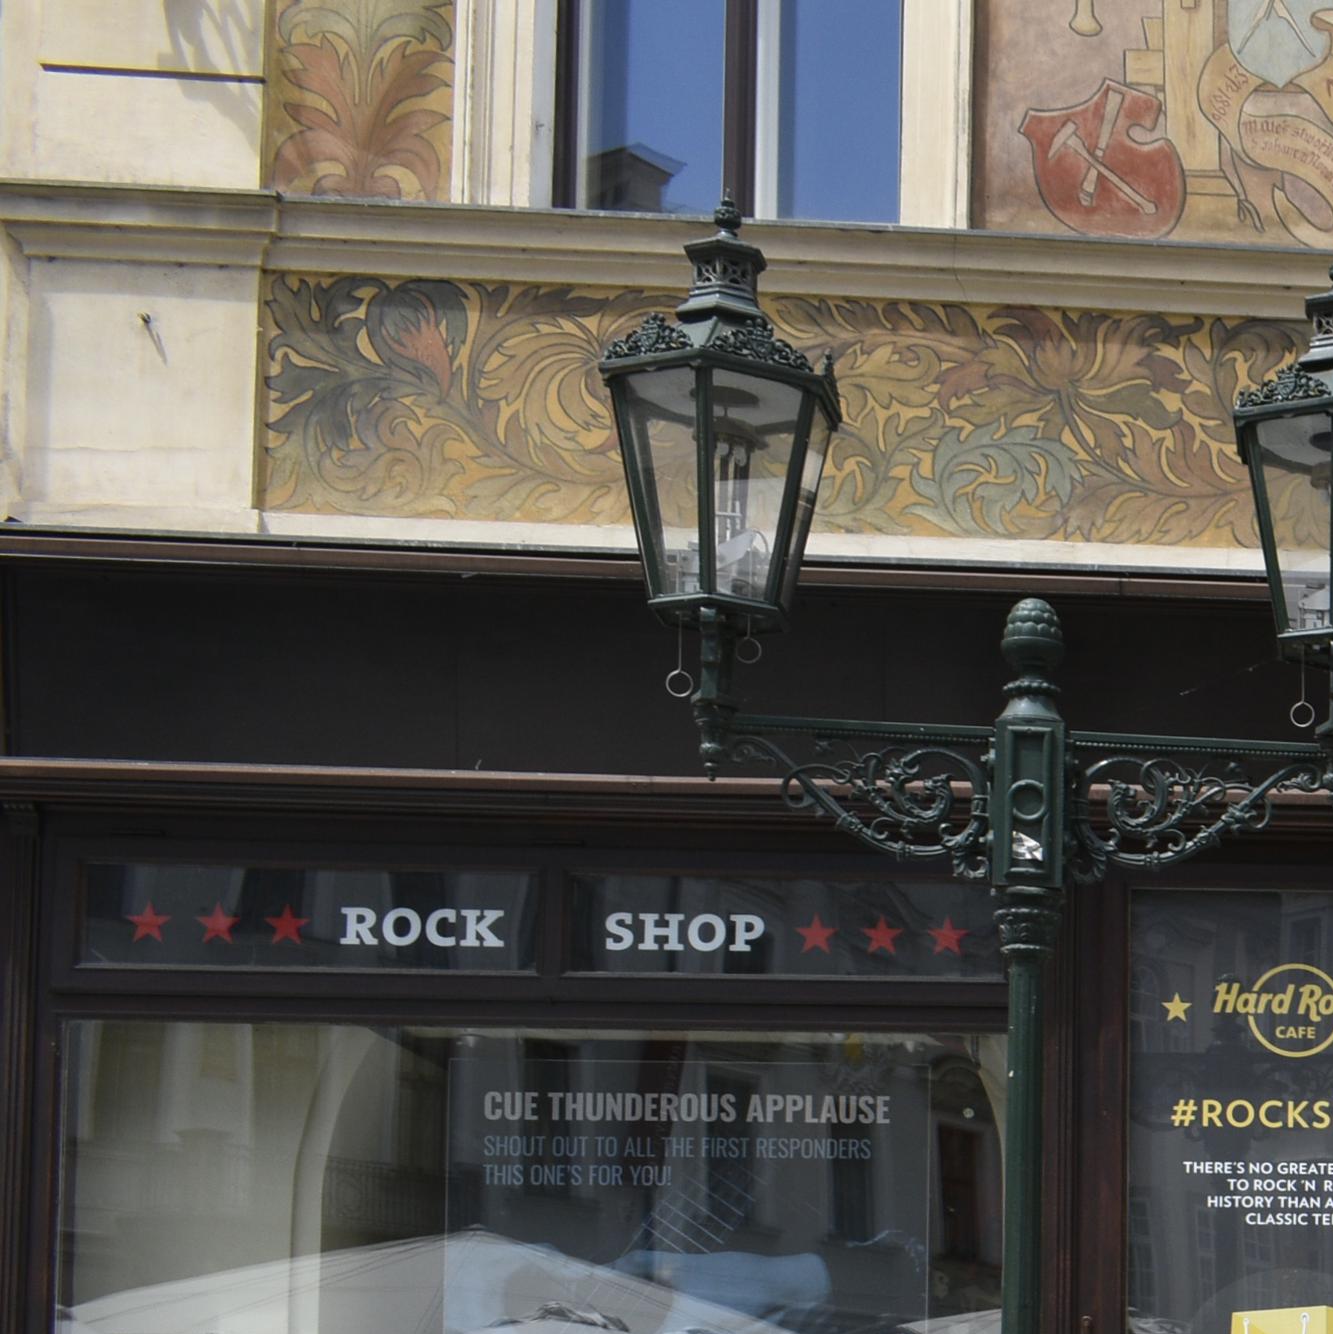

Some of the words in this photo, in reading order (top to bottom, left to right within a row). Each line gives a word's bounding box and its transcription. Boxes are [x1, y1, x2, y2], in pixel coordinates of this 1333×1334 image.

[340, 906, 504, 947] ROCK
[605, 911, 764, 952] SHOP
[1213, 982, 1295, 1014] Hard
[1275, 1026, 1316, 1040] CAFE
[483, 1091, 539, 1121] CUE
[548, 1091, 737, 1123] THUNDEROUS
[746, 1093, 891, 1124] APPLAUSE
[483, 1135, 545, 1158] SHOUT
[552, 1136, 589, 1158] OUT
[594, 1136, 618, 1158] TO
[624, 1136, 656, 1158] ALL
[664, 1136, 695, 1159] THE
[702, 1137, 749, 1159] FIRST
[756, 1138, 871, 1160] RESPONDERS
[483, 1164, 524, 1186] THIS
[588, 1164, 623, 1186] FOR
[630, 1164, 673, 1187] YOU!
[1249, 1162, 1272, 1174] NO
[1227, 1178, 1249, 1191] TO
[1253, 1178, 1296, 1191] ROCK
[1207, 1195, 1273, 1208] HISTORY
[1278, 1195, 1320, 1208] THAN
[1245, 1212, 1307, 1225] CLASSIC
